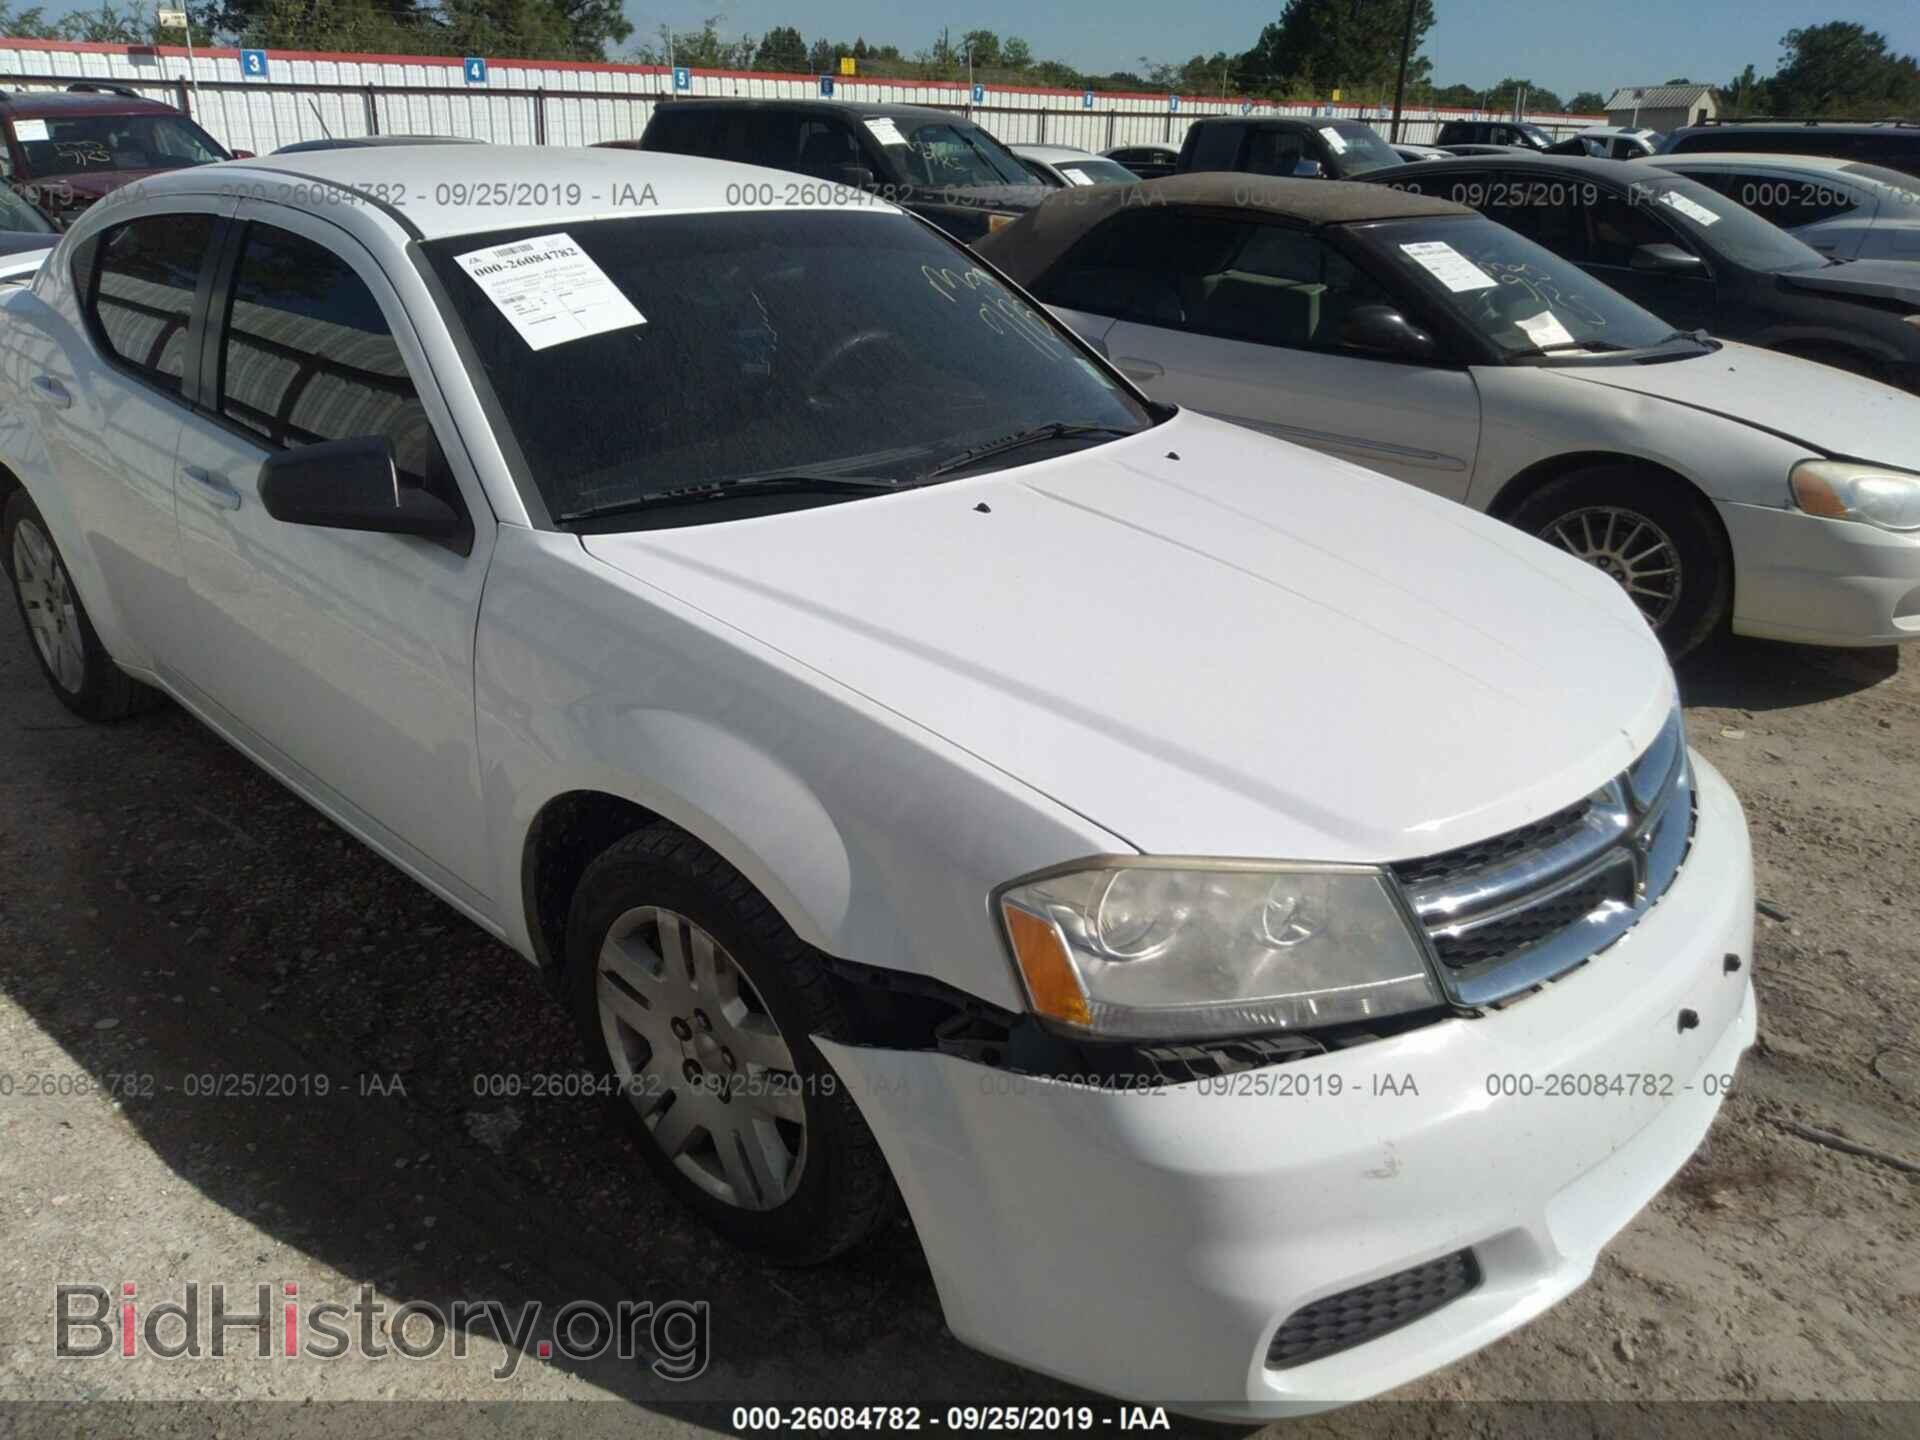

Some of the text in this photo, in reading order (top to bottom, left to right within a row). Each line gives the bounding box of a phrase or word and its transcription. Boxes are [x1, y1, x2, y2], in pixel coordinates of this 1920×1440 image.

[248, 54, 260, 72] 3
[470, 63, 480, 79] 4
[678, 71, 686, 86] 5
[473, 246, 579, 278] 000-26084782
